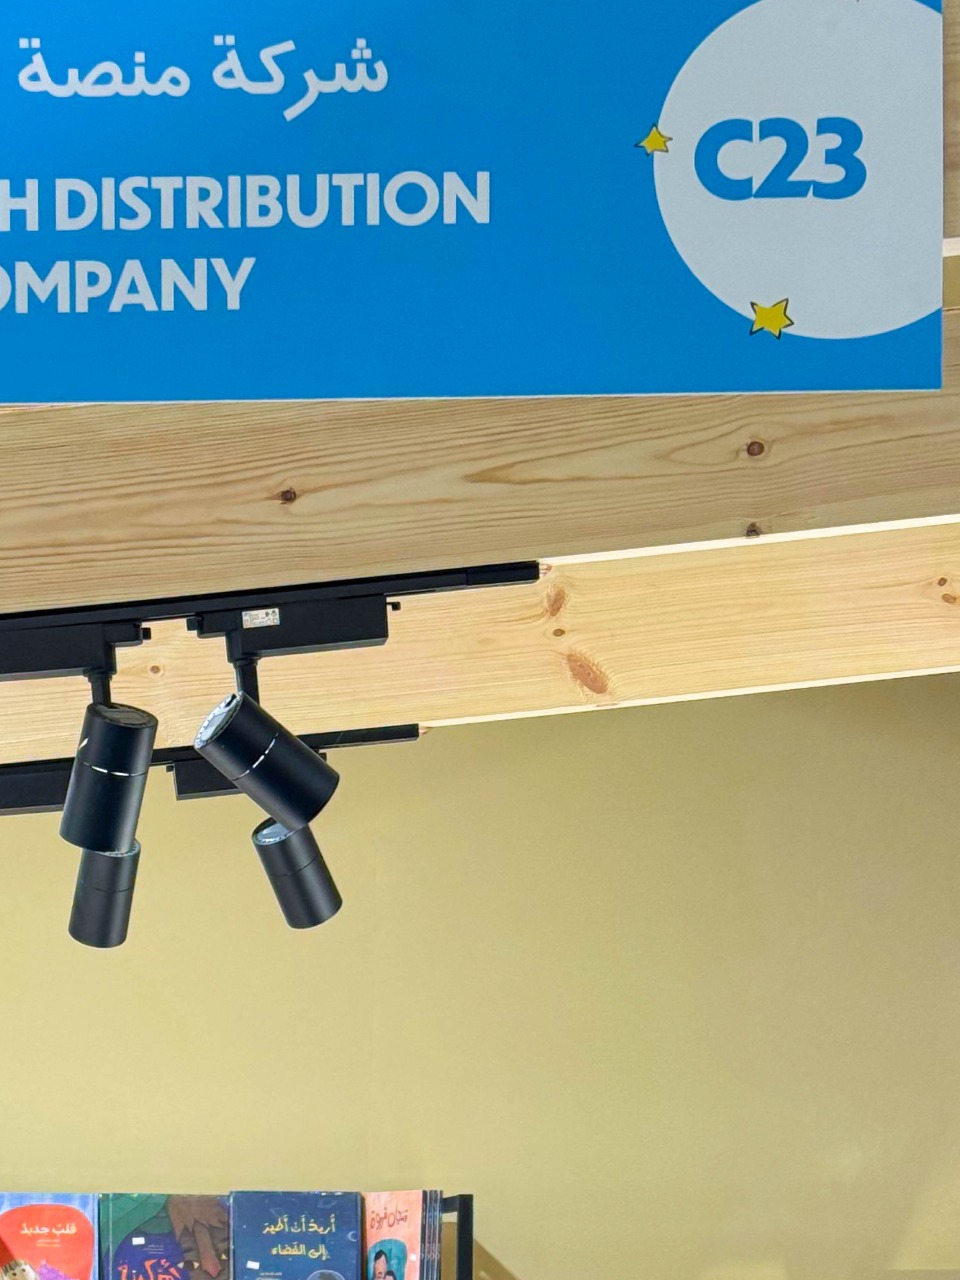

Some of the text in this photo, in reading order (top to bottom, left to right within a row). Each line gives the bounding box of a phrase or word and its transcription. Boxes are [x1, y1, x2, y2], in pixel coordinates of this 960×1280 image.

[19, 39, 190, 97] منصة
[213, 36, 387, 119] شركة
[694, 116, 866, 201] C23
[56, 172, 489, 231] DISTRIBUTION
